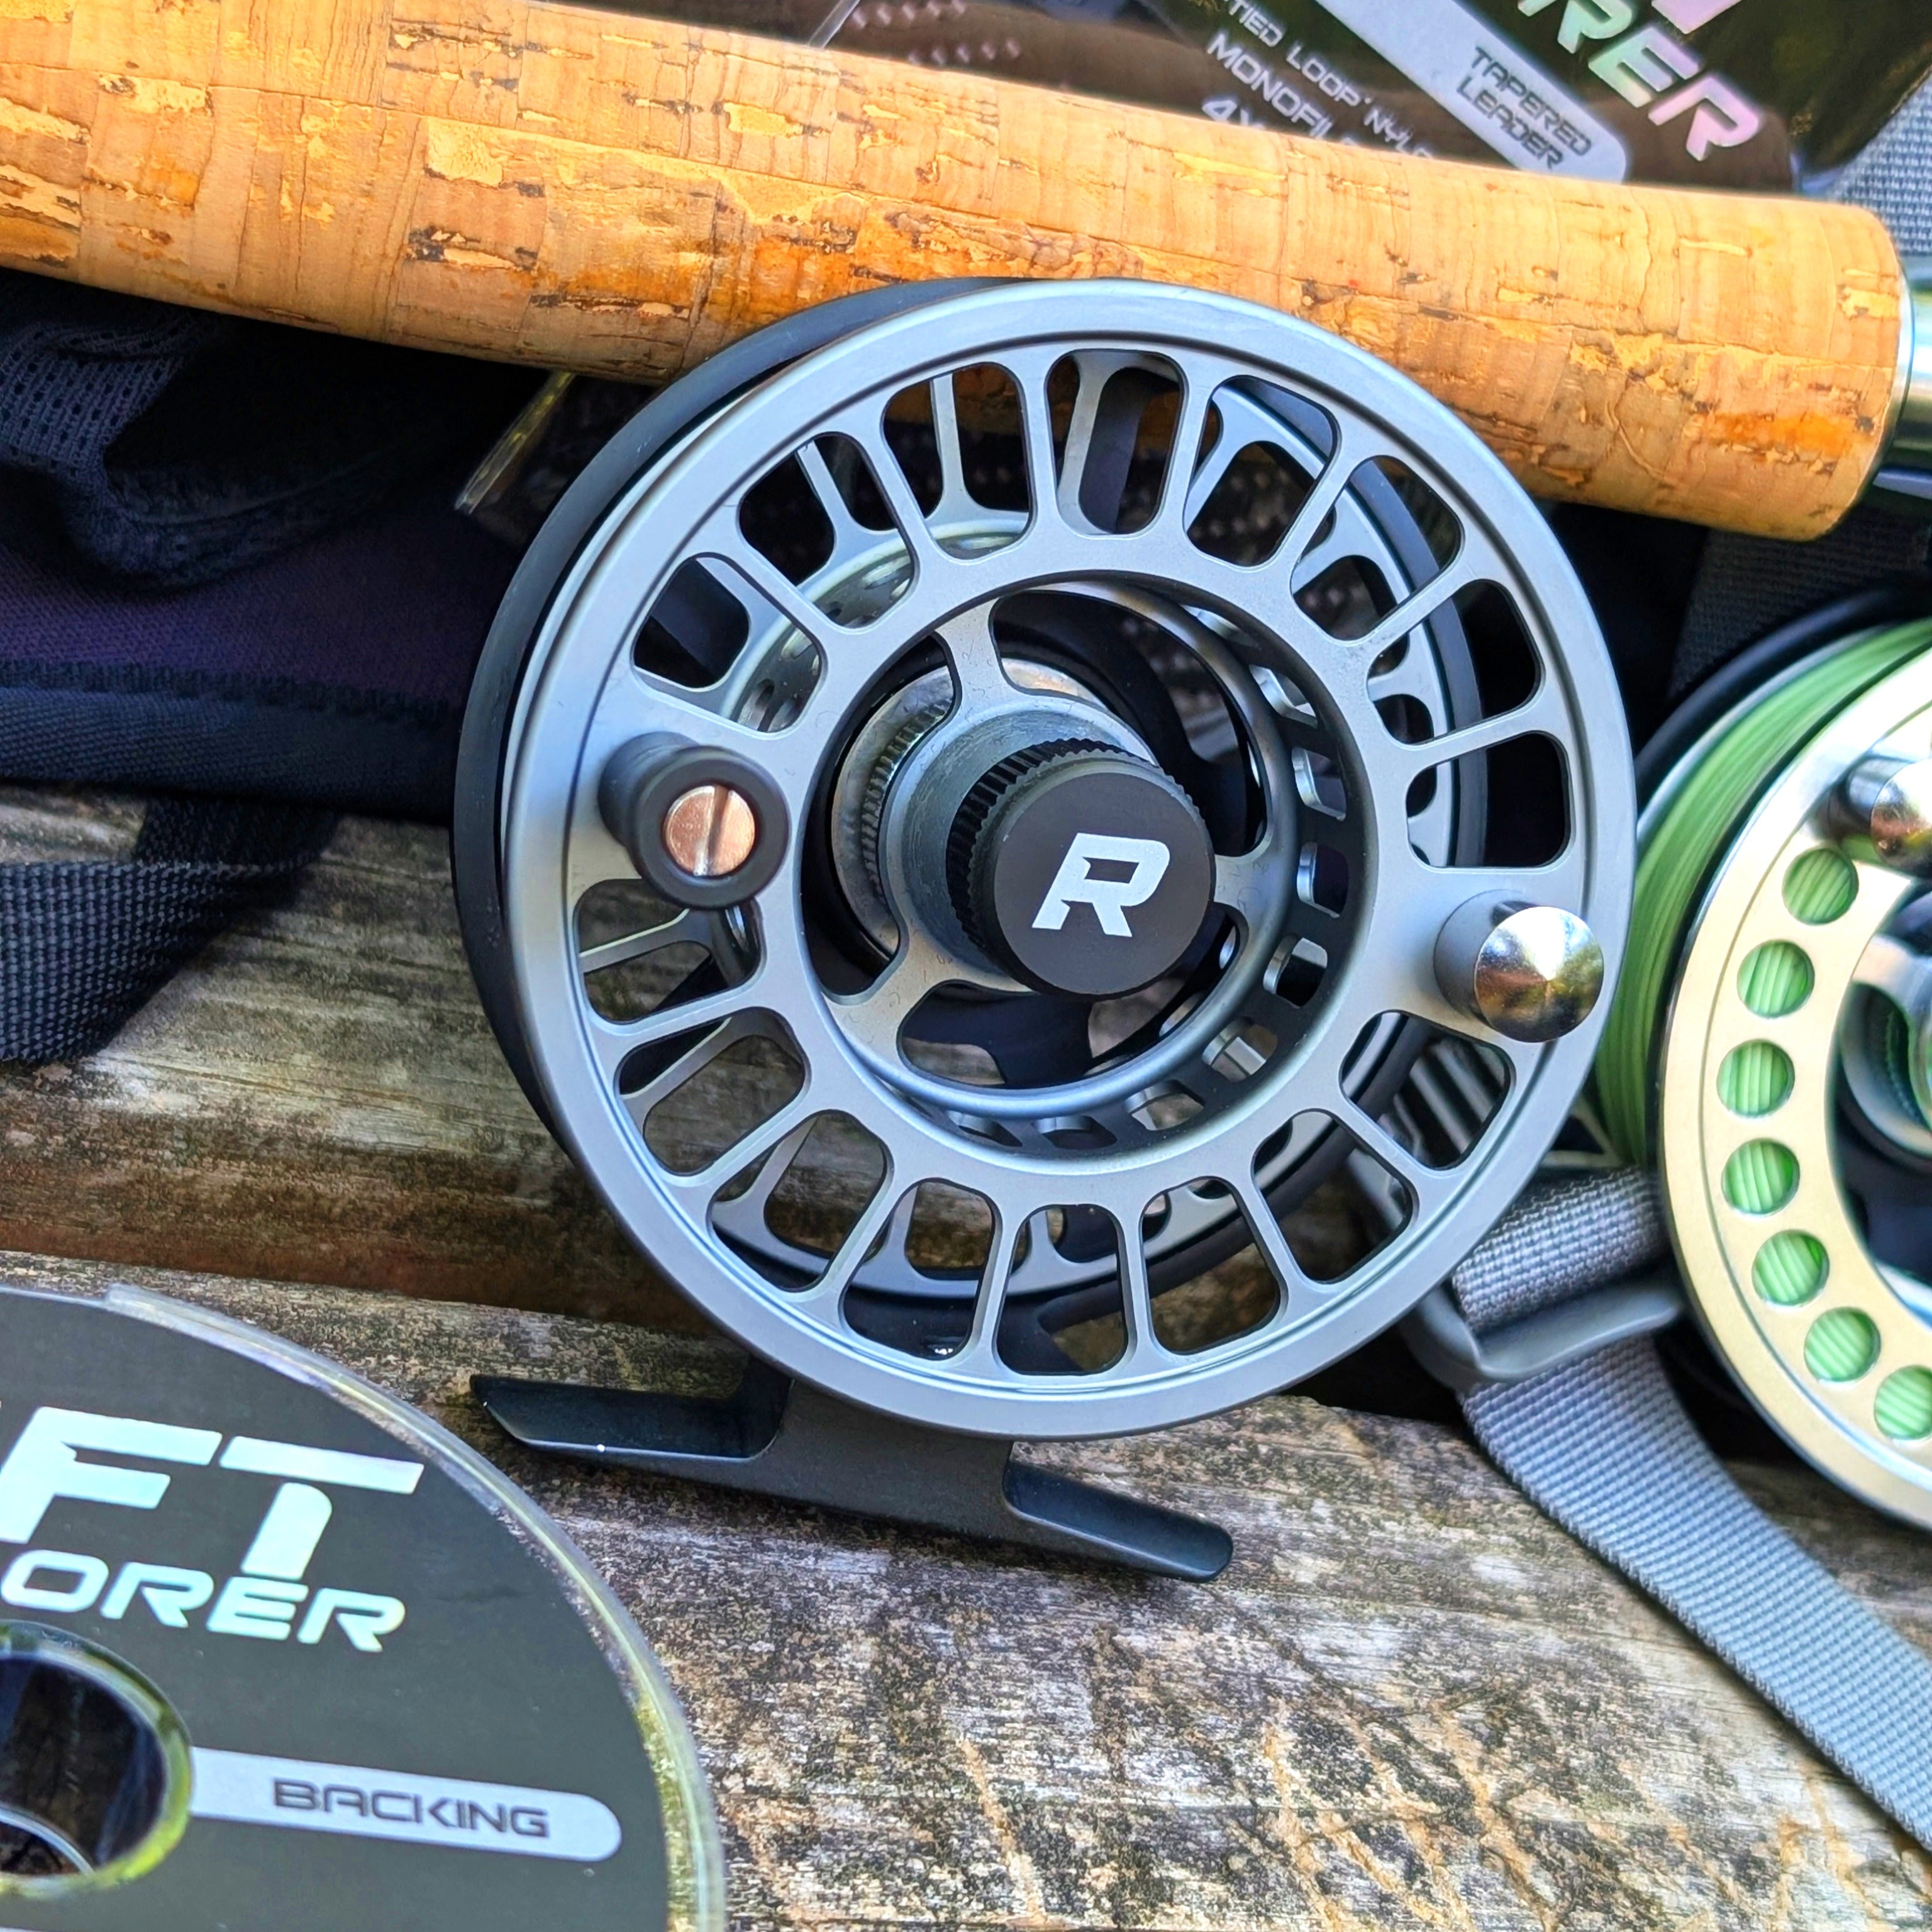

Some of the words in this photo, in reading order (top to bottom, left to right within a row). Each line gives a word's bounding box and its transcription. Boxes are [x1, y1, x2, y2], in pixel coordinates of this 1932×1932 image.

[1456, 75, 1564, 169] LEADER
[1471, 45, 1592, 157] TAPERED
[1031, 832, 1170, 937] R
[1, 1550, 406, 1653] ORER
[273, 1777, 550, 1838] BACKING
